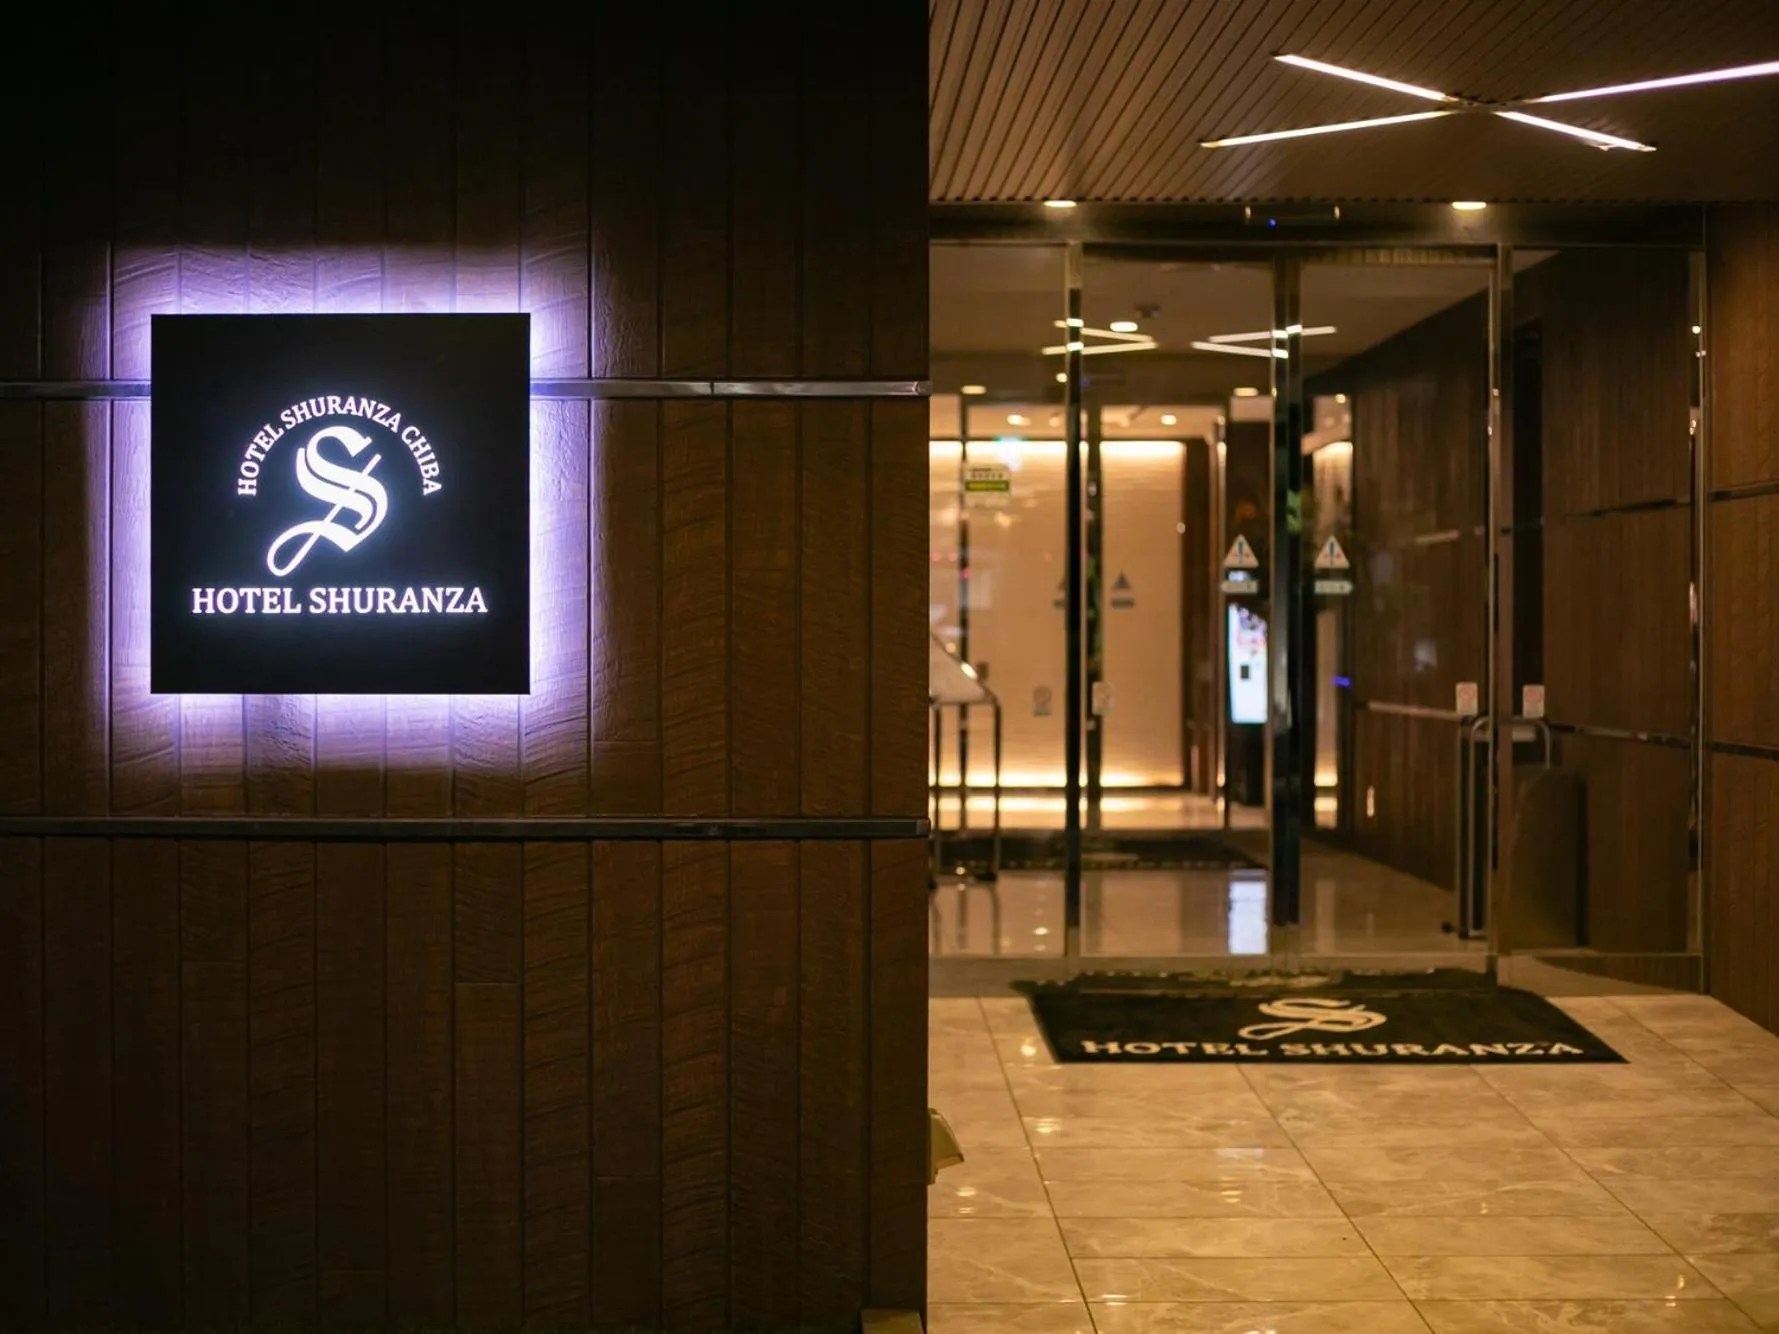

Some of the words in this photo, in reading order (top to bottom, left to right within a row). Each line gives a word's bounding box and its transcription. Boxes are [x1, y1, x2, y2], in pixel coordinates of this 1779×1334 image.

[237, 423, 285, 496] HOTEL
[280, 395, 402, 434] SHURANZA
[401, 426, 442, 496] CHIBA
[191, 587, 302, 614] HOTEL
[308, 587, 488, 614] SHURANZA
[1081, 1040, 1268, 1056] HOTEL
[1281, 1042, 1583, 1056] SHURANZA
